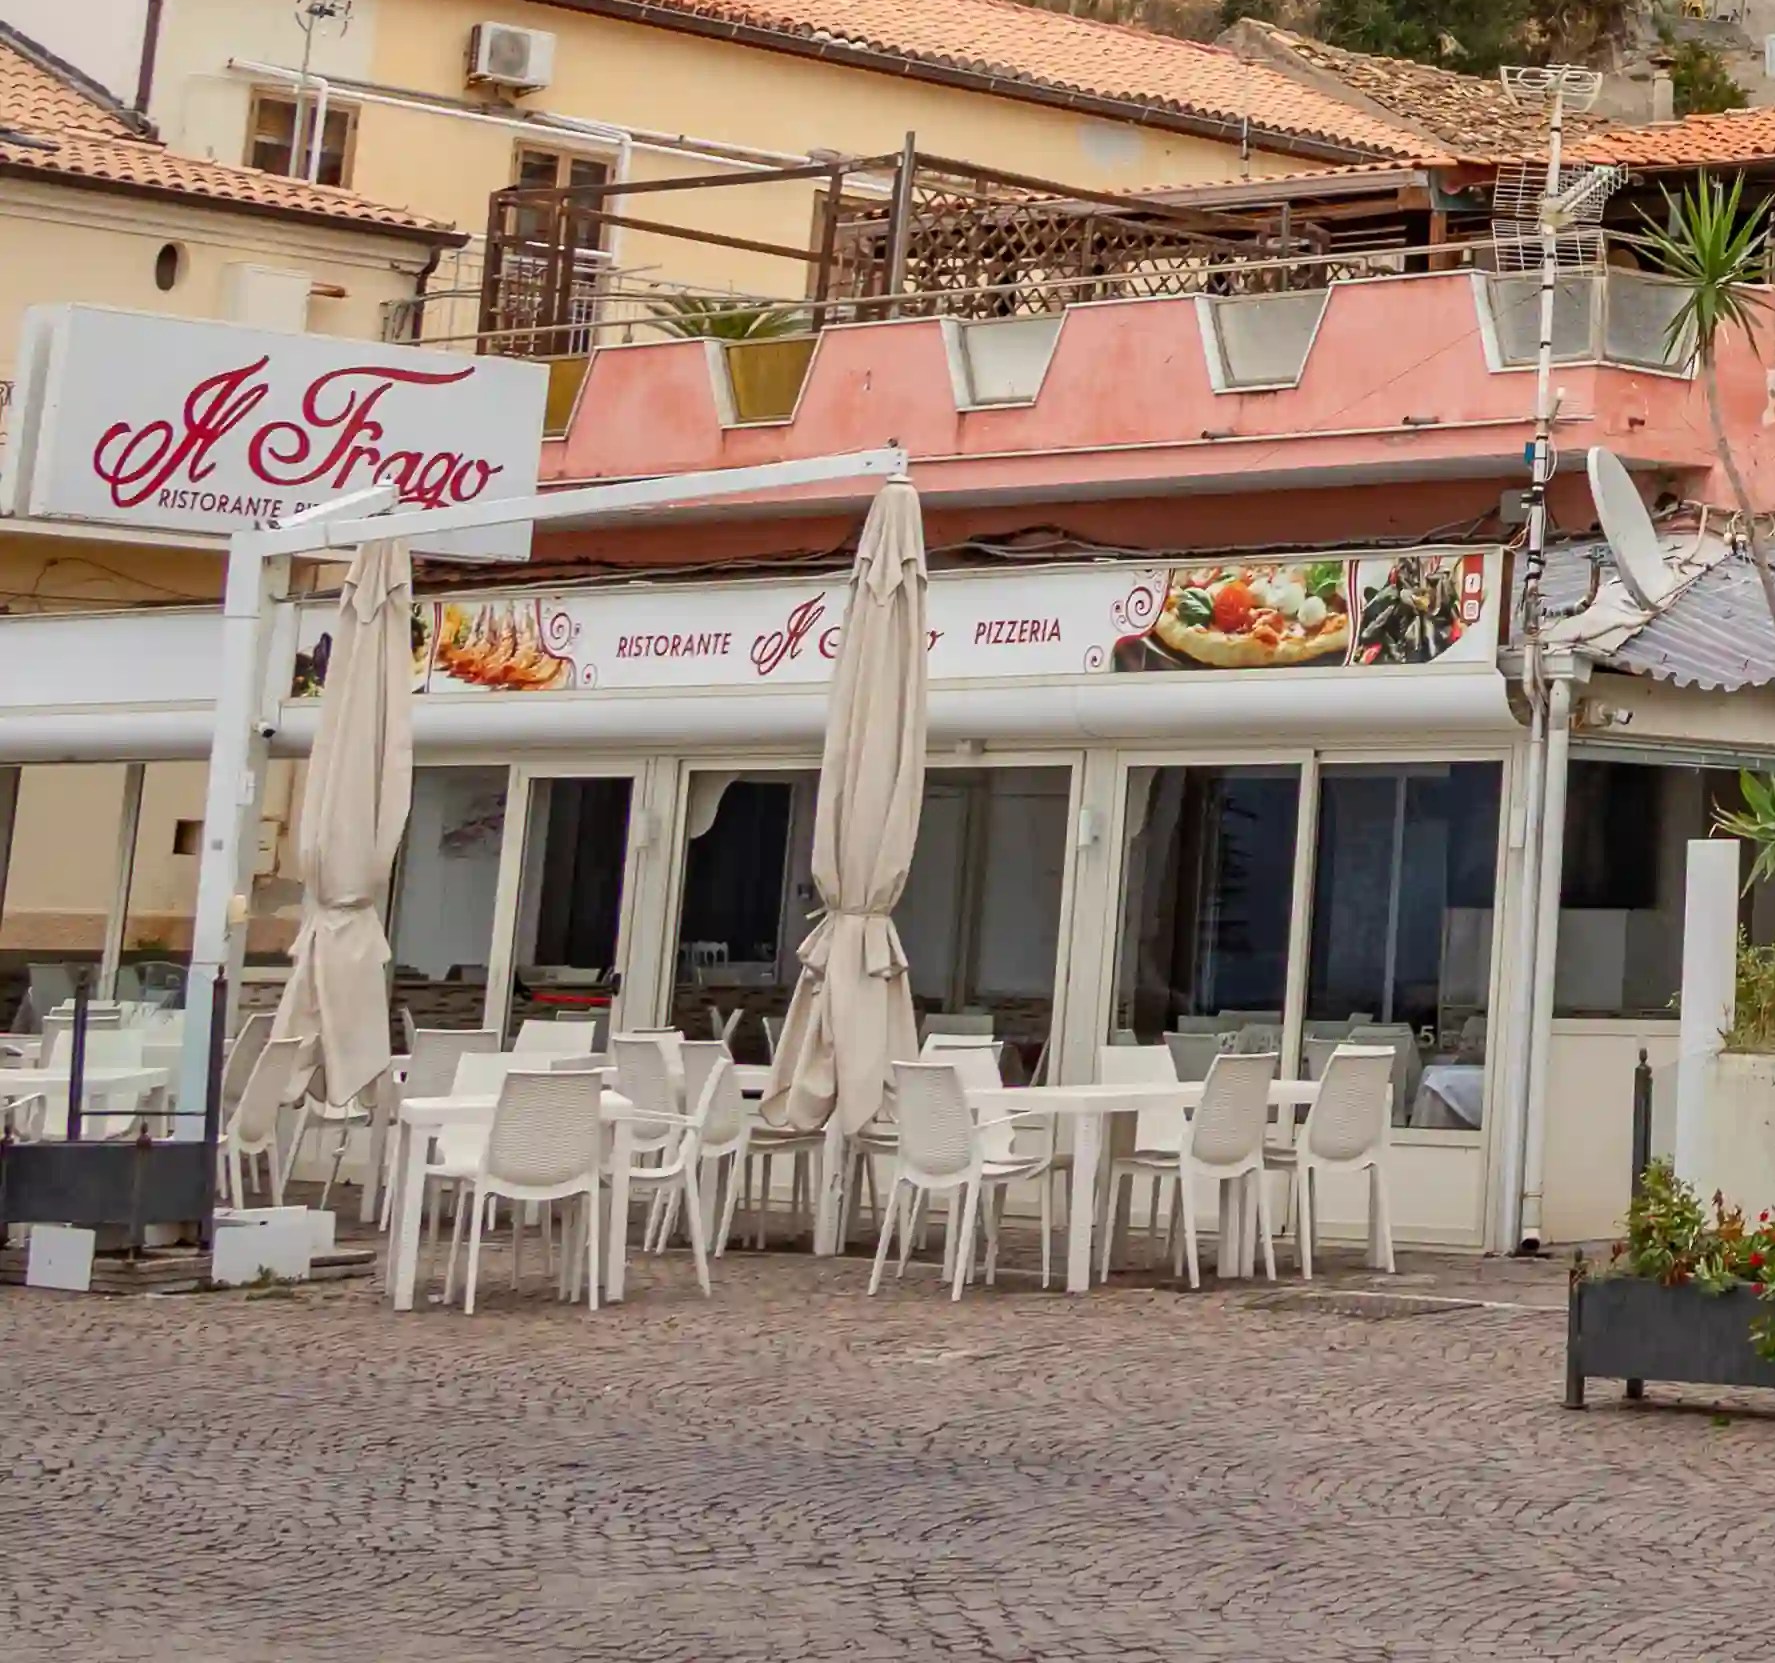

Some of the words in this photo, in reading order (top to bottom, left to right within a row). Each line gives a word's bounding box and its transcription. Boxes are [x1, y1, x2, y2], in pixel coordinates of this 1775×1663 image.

[249, 367, 503, 510] Frago
[158, 488, 282, 518] RISTORANTE
[616, 632, 732, 658] RISTORANTE
[975, 617, 1061, 645] PIZZERIA
